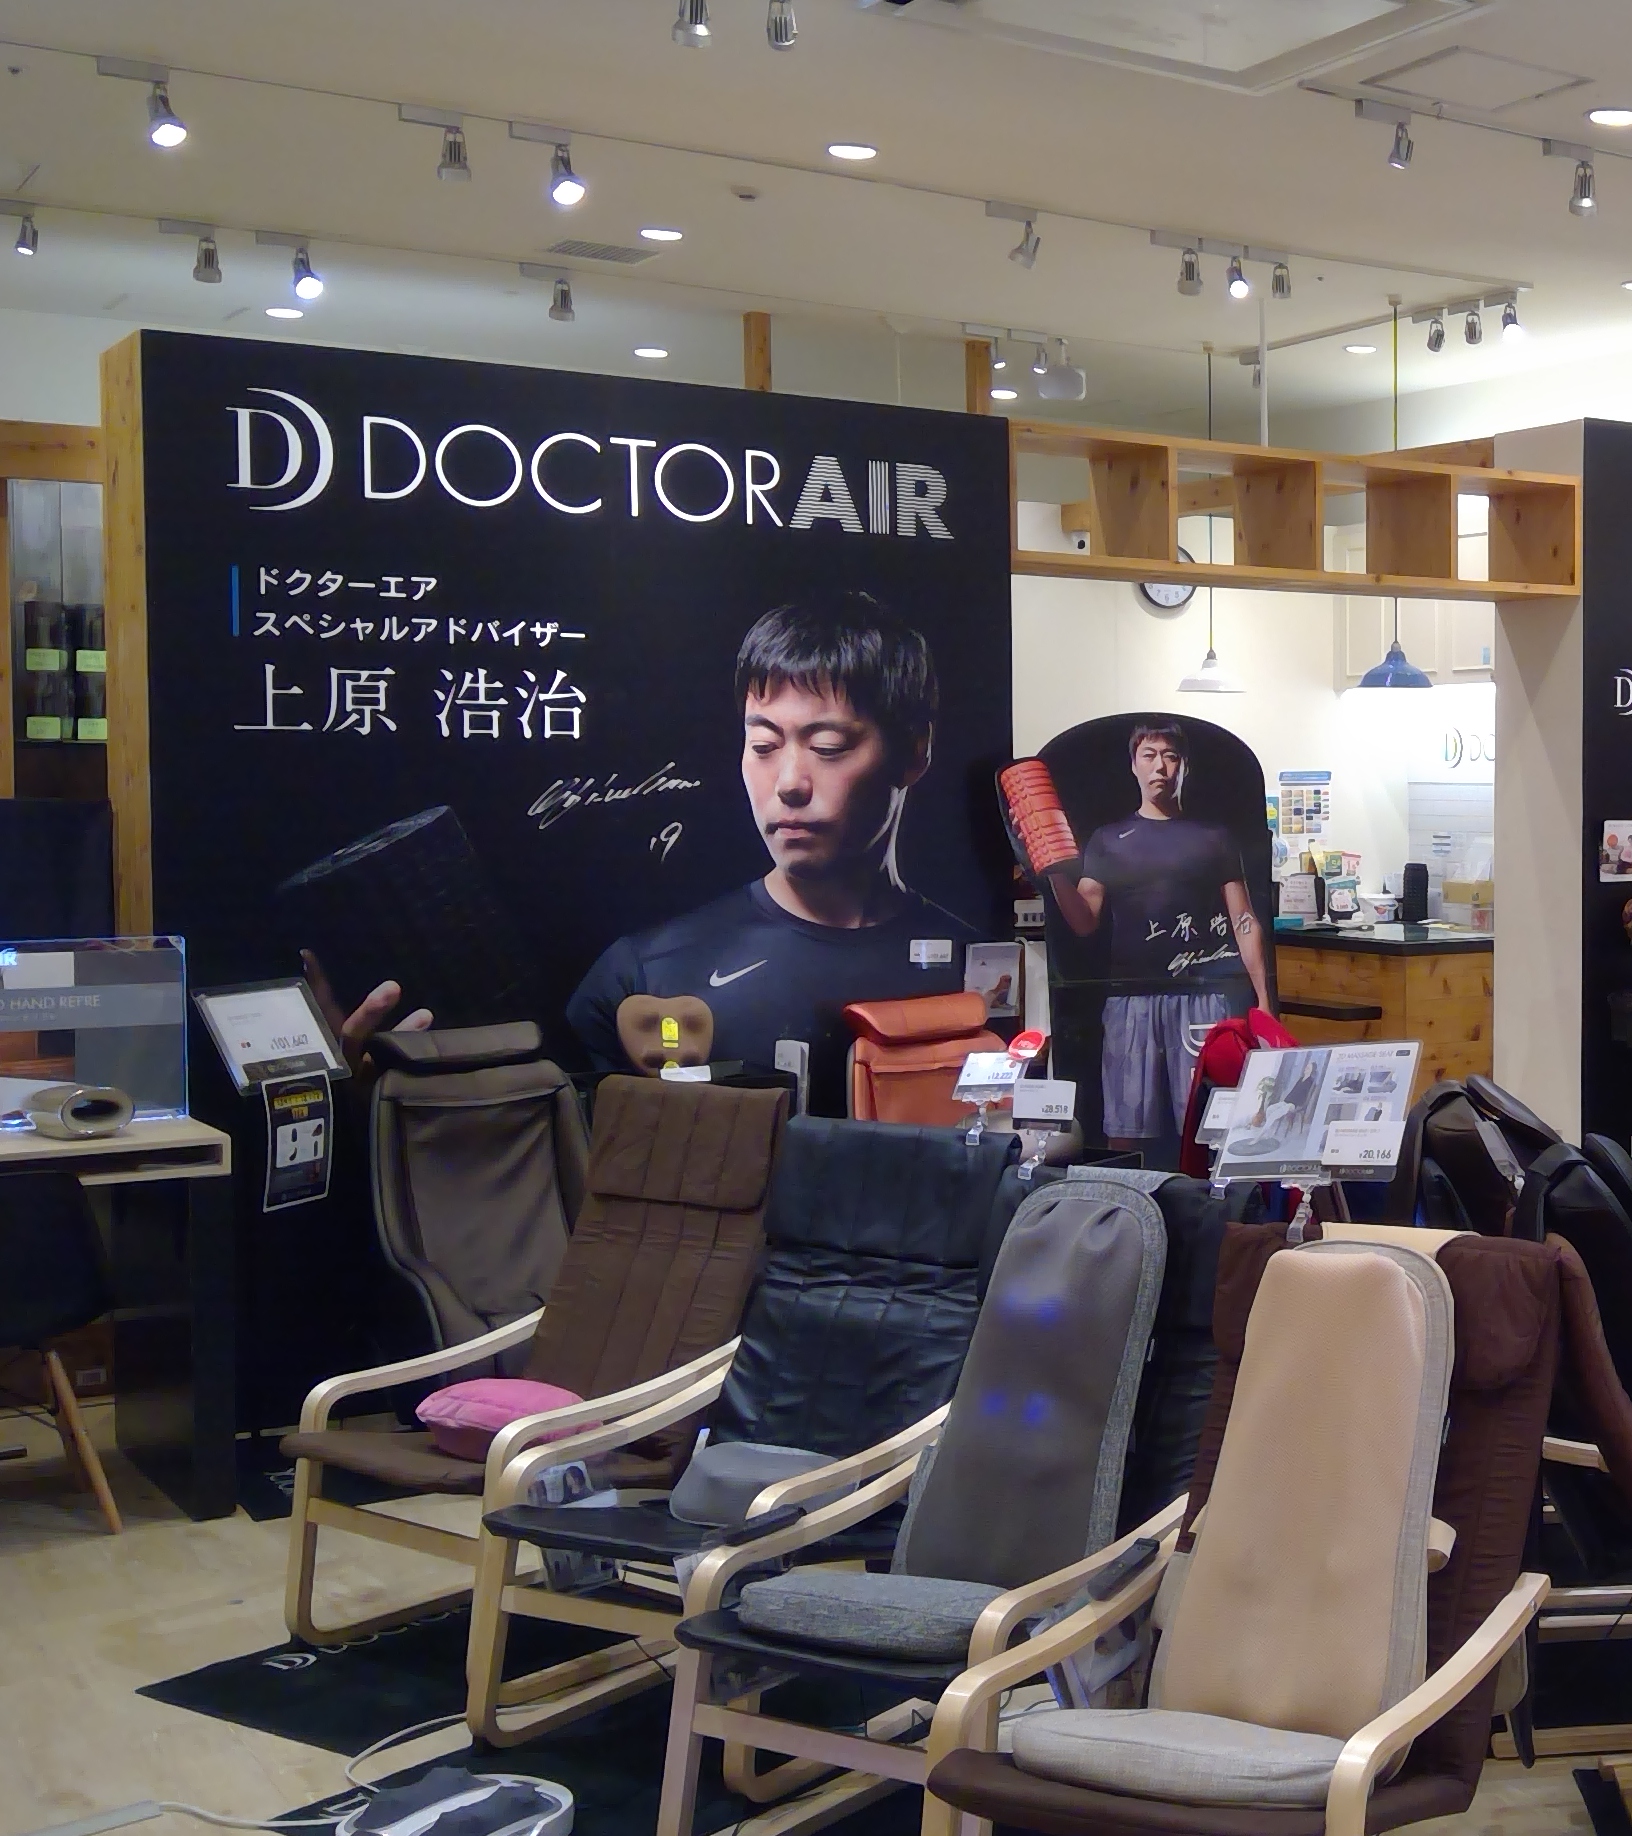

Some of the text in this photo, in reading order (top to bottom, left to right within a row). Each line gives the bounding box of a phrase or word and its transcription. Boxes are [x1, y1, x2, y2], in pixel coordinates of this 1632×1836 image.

[363, 416, 955, 541] DOCTORAIR
[257, 569, 438, 602] ドクターエア
[253, 611, 586, 649] スペシャルアドバイザー
[234, 663, 588, 740] 上原 浩治
[10, 995, 55, 1010] HAND
